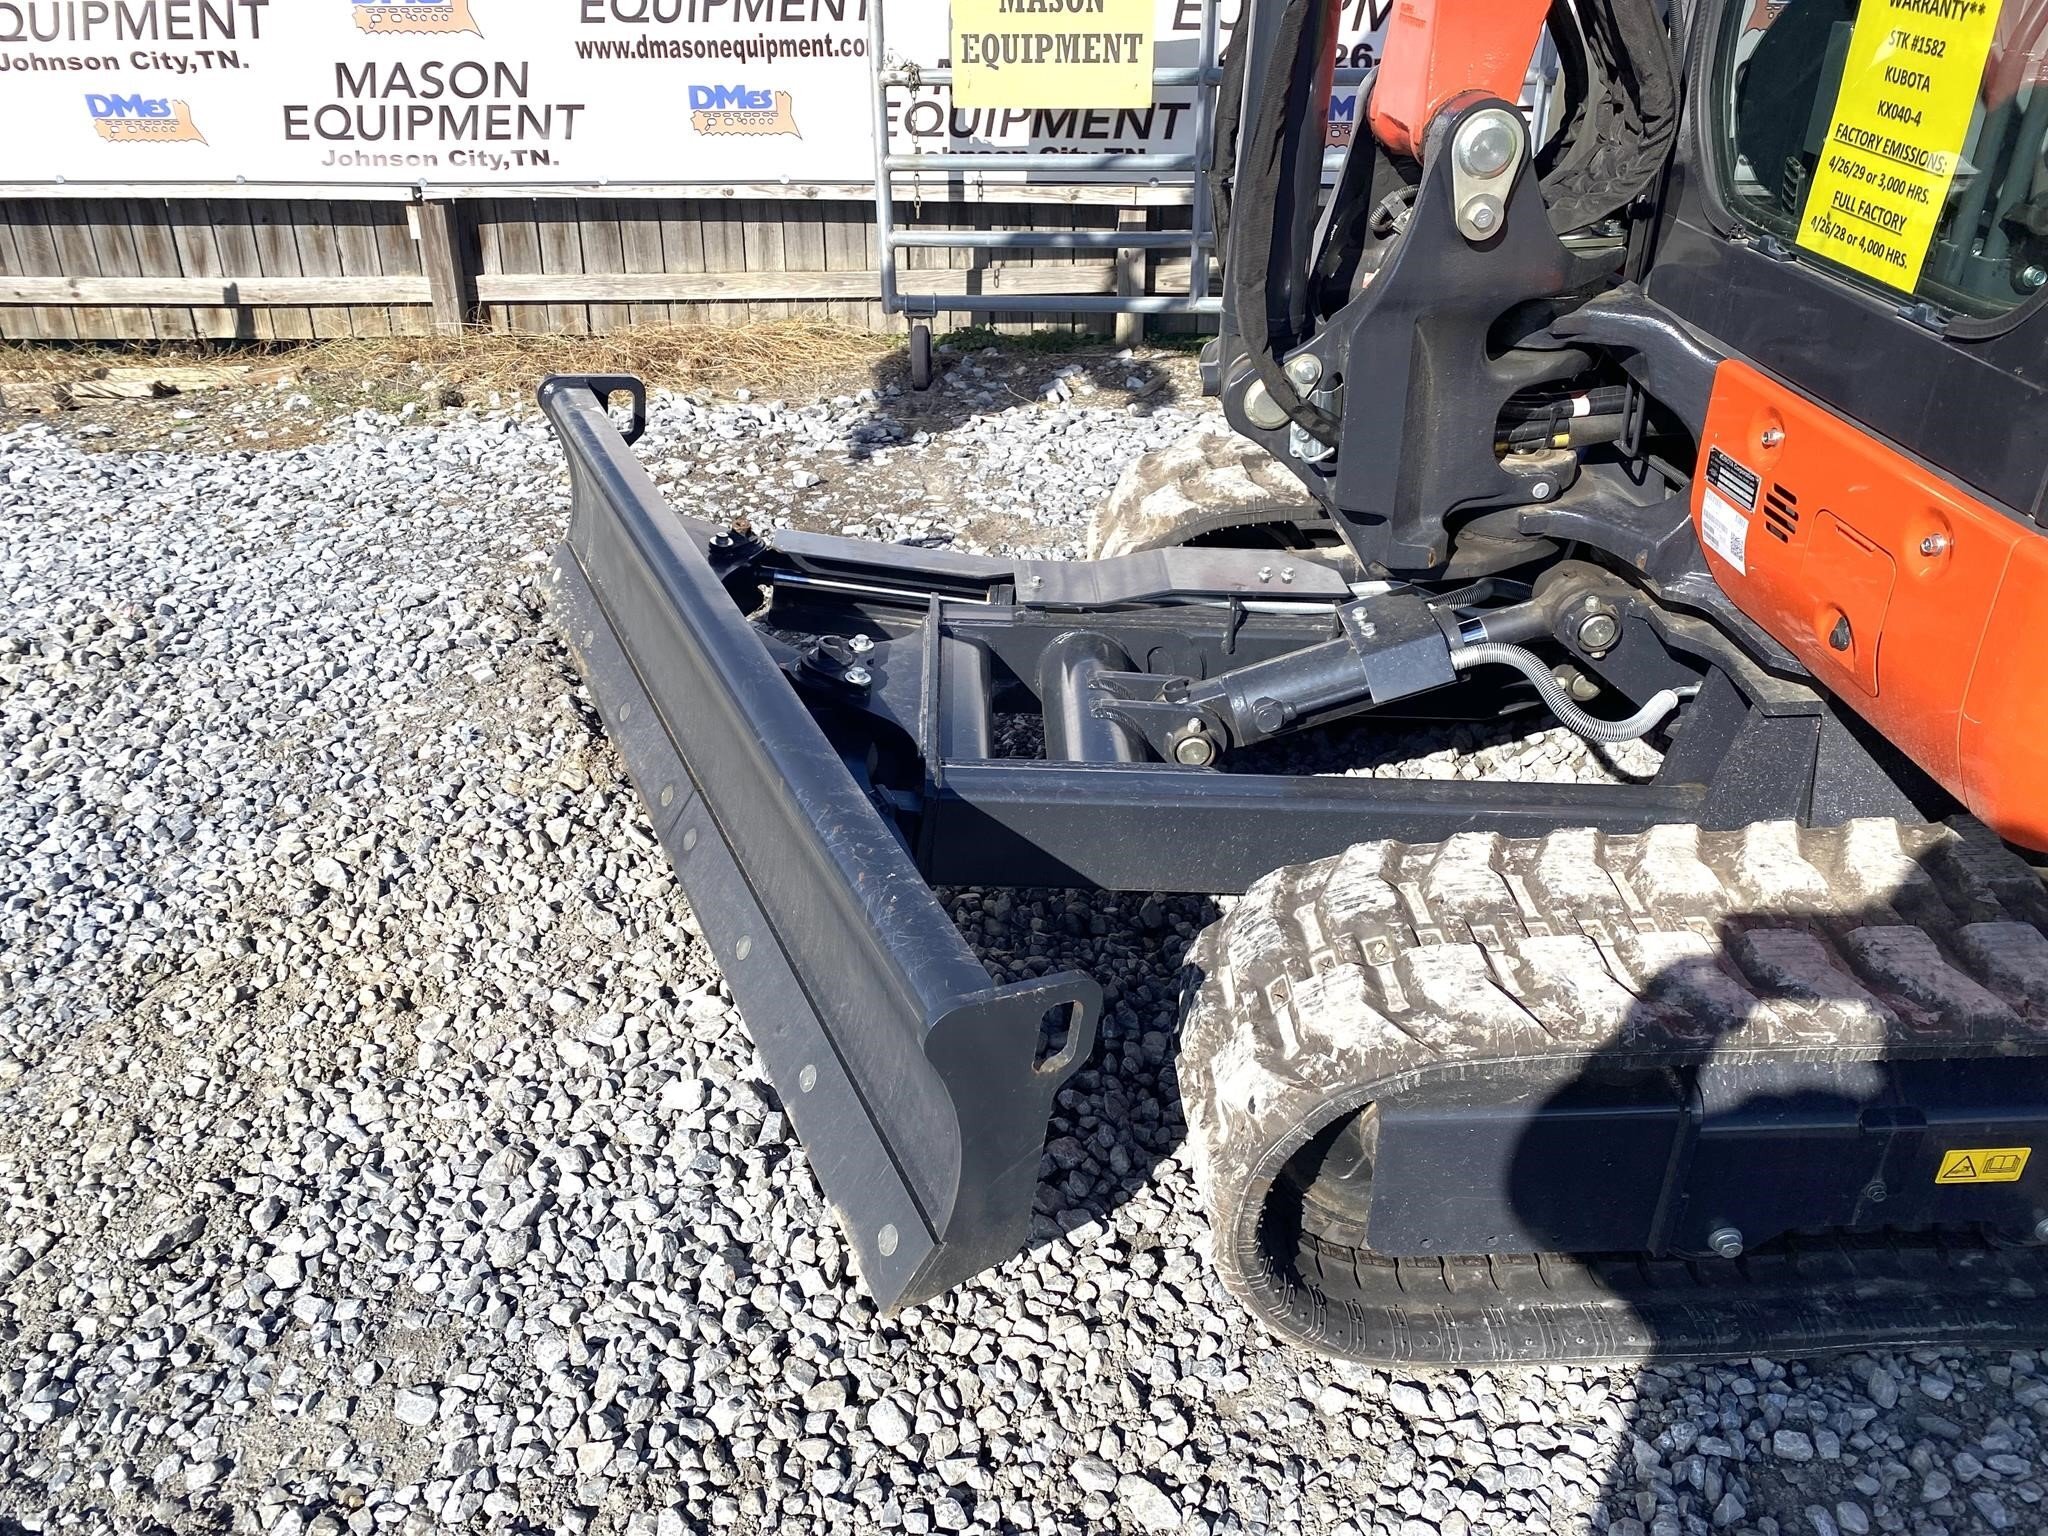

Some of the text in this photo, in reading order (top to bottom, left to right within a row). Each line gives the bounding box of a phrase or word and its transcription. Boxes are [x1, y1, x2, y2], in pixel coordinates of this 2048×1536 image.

[580, 0, 868, 24] EQUIPMEN
[574, 33, 869, 64] www.dmasonequipment.co
[961, 33, 1144, 70] EQUIPMENT
[1888, 30, 1946, 58] STK #1582
[0, 52, 120, 72] Johnson
[1884, 65, 1931, 93] KUBOTA
[334, 60, 529, 99] MASON
[283, 103, 586, 142] EQUIPMENT
[1877, 100, 1923, 127] KX040-4
[321, 149, 438, 168] Johnson
[1835, 123, 1948, 173] FACTORY EMISSIONS:
[1828, 155, 1929, 205] 4/26/29 or 3,000 HRS.
[1833, 190, 1908, 232] FULL FACTORY
[1811, 215, 1908, 269] 4/26/28 or 4,000 HRS.
